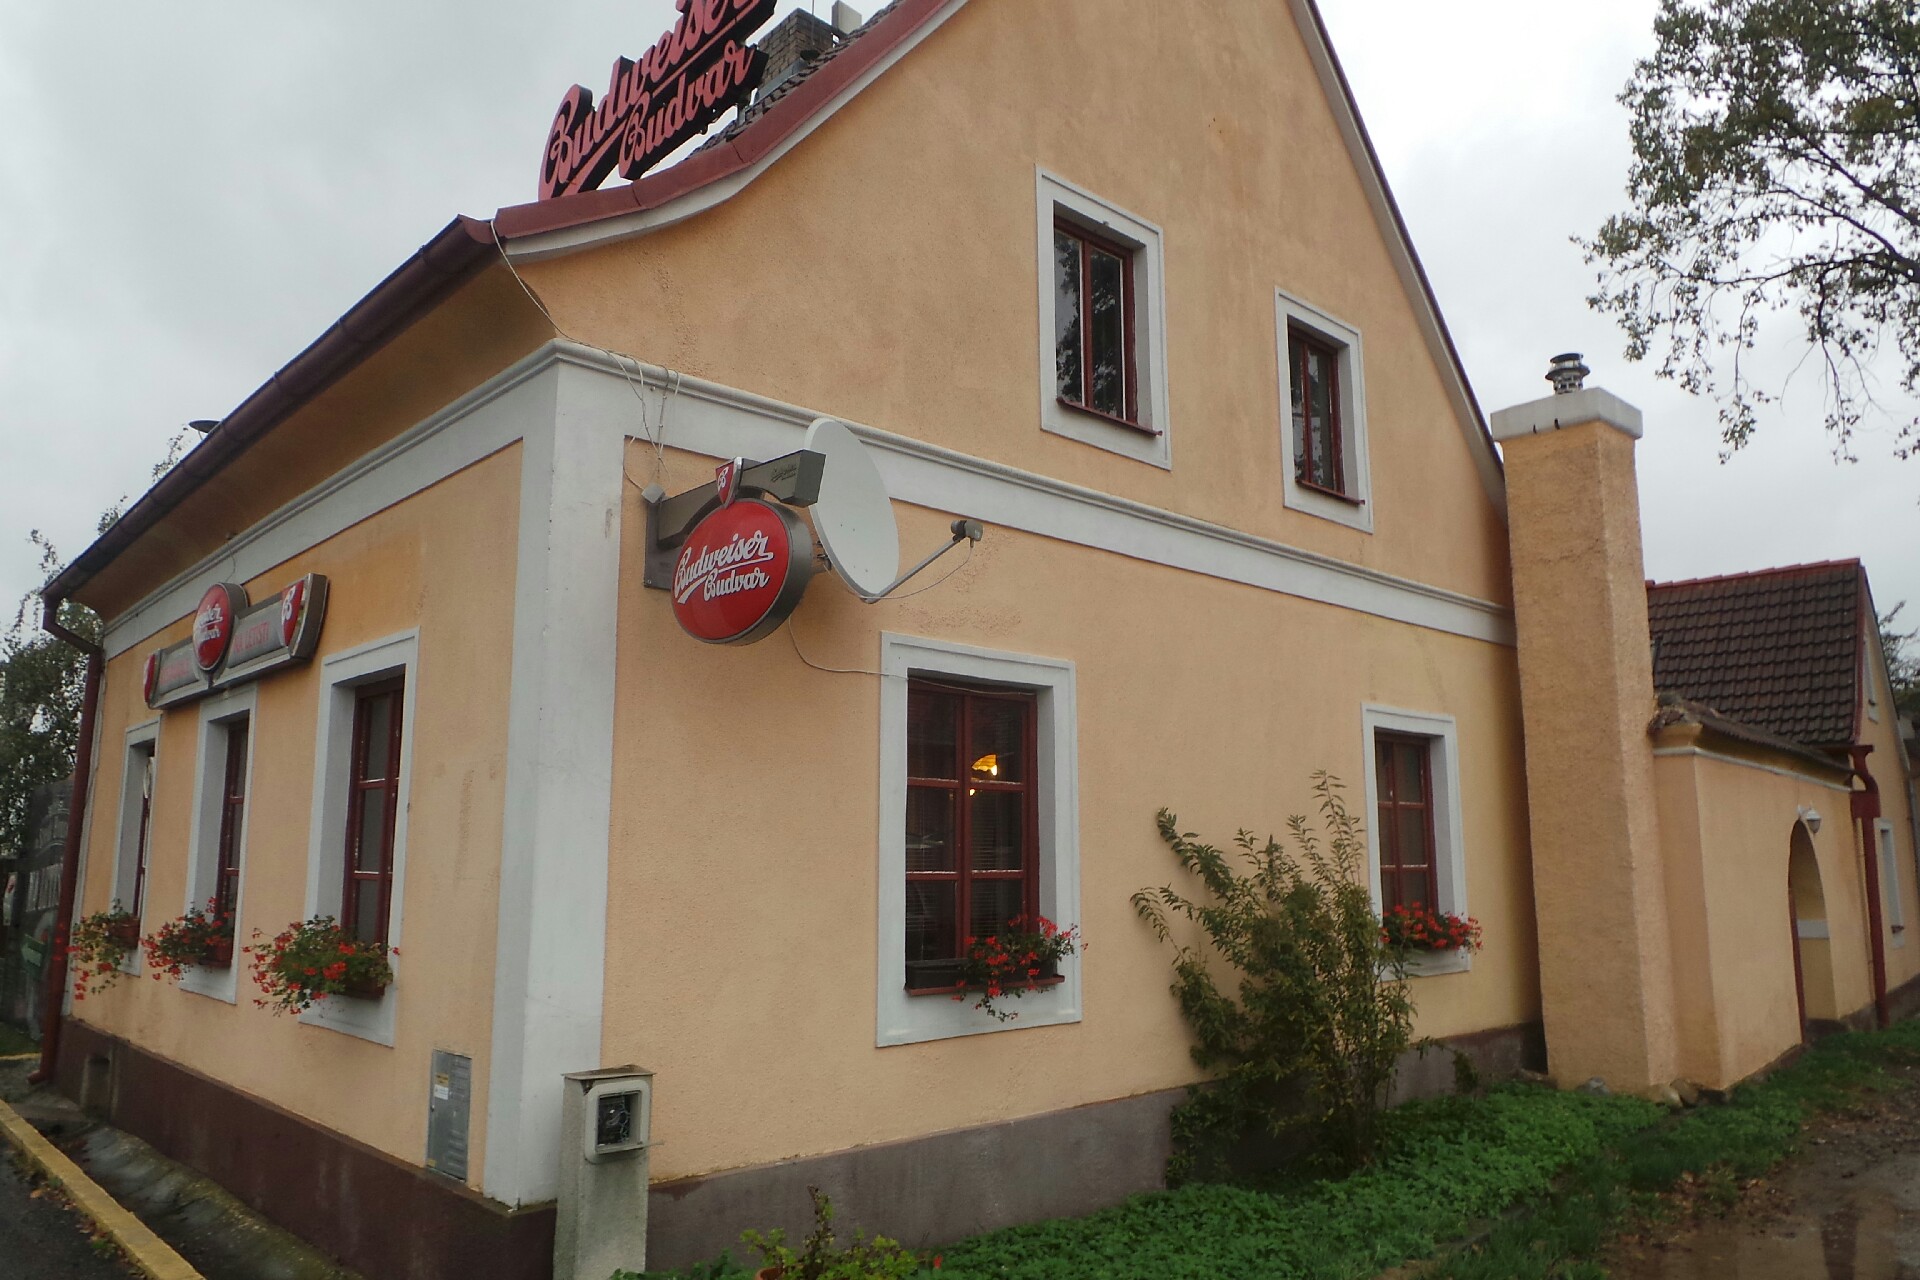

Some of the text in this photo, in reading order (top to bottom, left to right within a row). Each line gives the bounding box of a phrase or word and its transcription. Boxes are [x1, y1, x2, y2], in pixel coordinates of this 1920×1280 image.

[538, 0, 762, 199] Budweise
[619, 40, 757, 180] Budvar
[674, 530, 774, 602] Budweiser
[703, 567, 770, 602] Budvar
